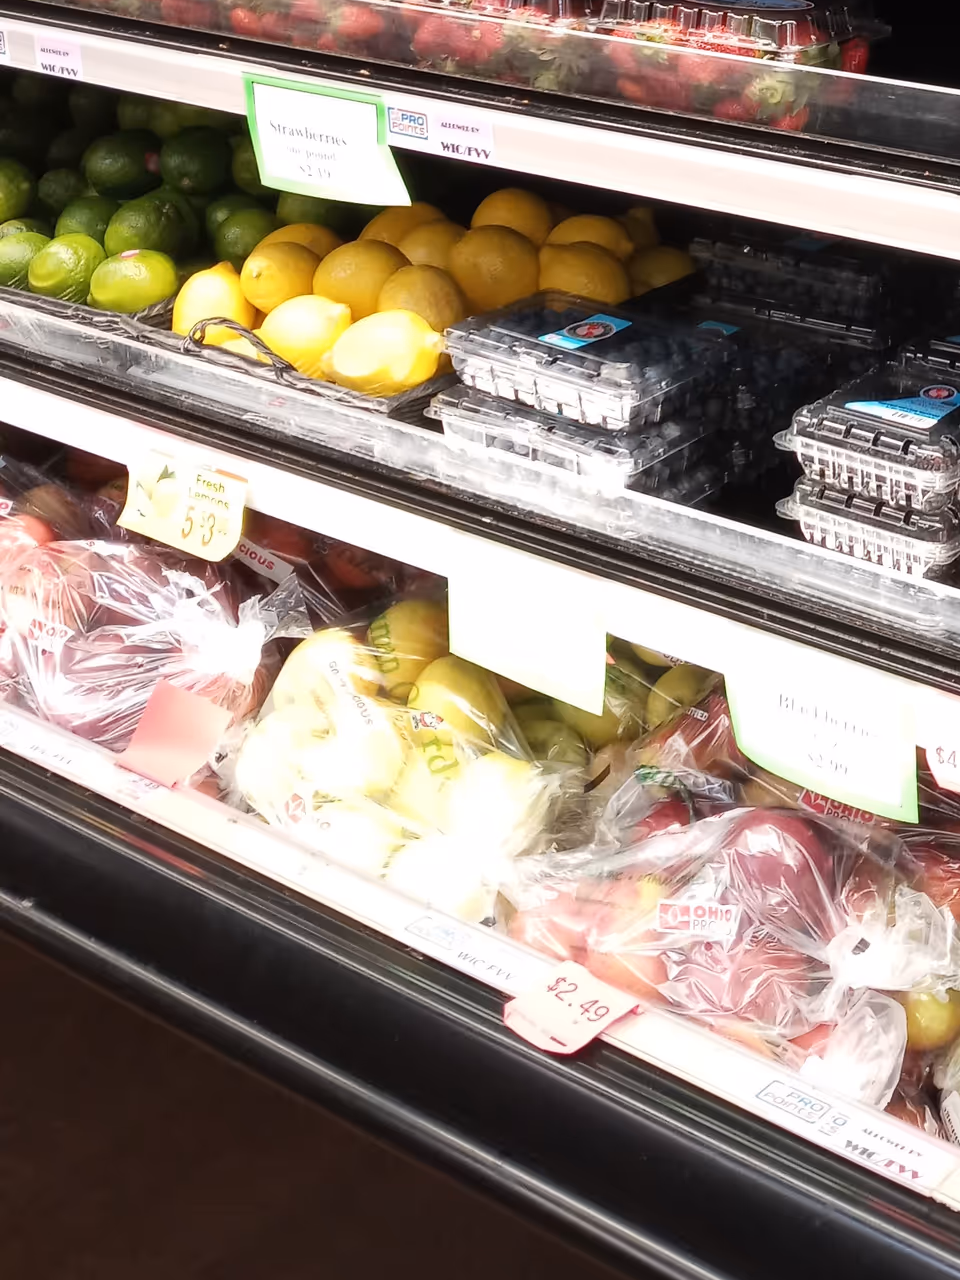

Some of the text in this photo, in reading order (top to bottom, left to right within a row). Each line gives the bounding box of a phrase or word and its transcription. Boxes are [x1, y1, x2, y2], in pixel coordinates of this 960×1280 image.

[401, 113, 425, 126] PRO
[269, 120, 348, 147] Strawberries
[440, 141, 492, 160] WIC/FVV
[196, 474, 226, 493] Fresh
[693, 905, 732, 923] OHIO
[546, 976, 611, 1022] $2.49
[786, 1091, 825, 1113] PRO
